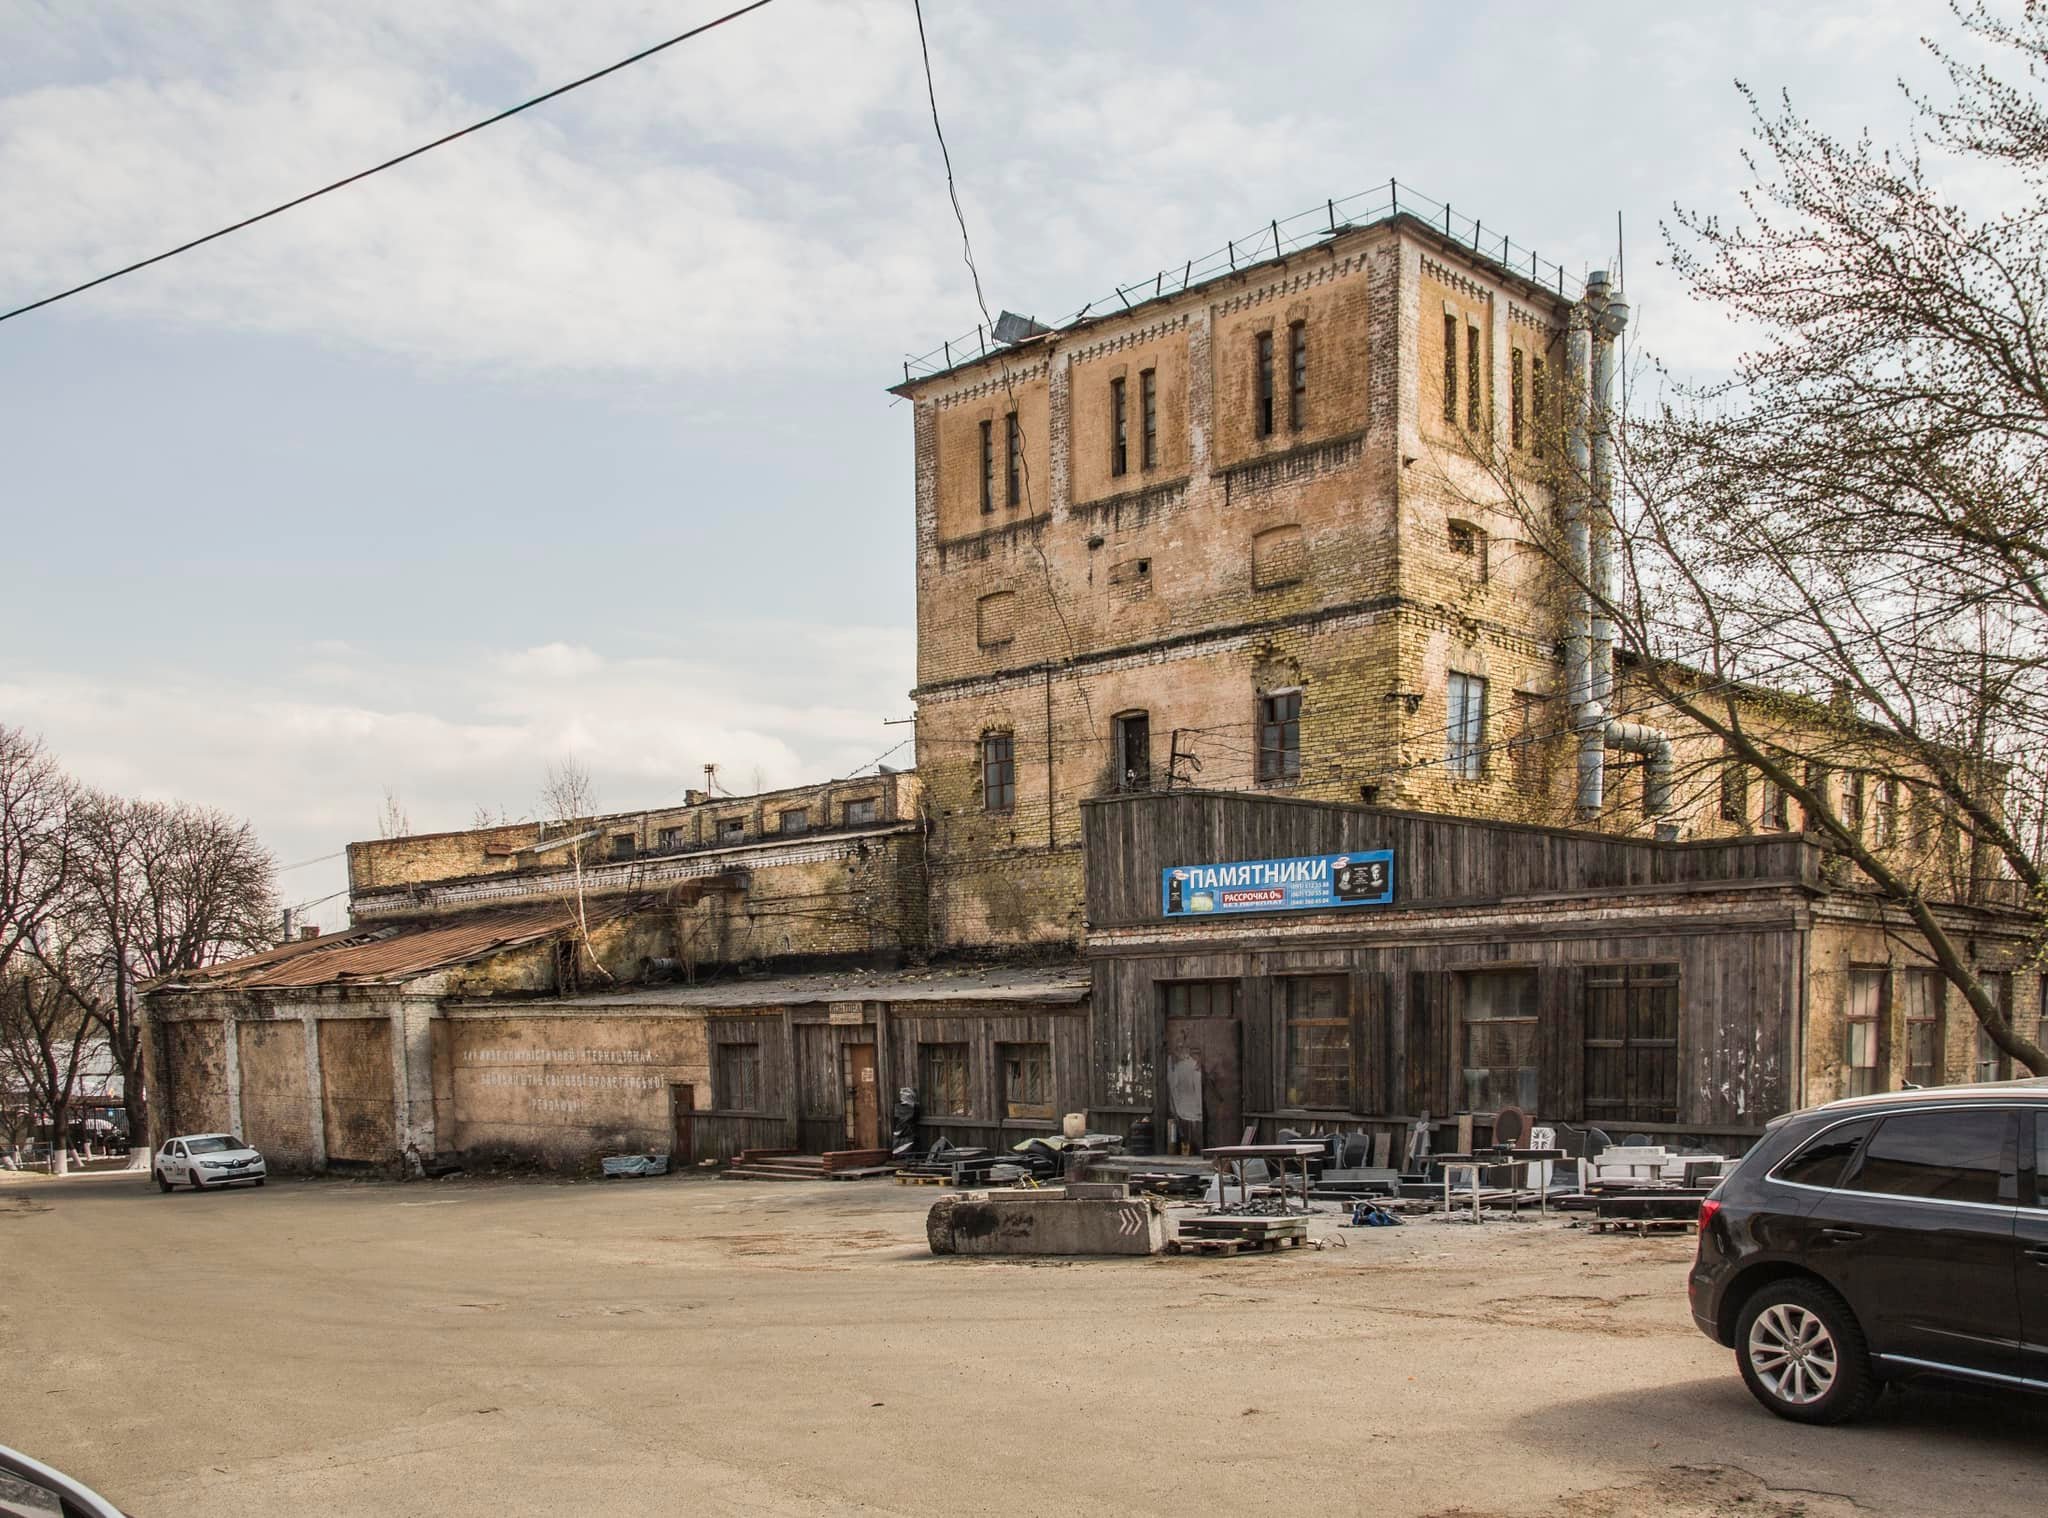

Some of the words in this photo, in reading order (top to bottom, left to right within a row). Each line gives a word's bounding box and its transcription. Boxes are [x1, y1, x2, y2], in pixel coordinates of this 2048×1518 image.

[1190, 859, 1326, 889] ПАМЯТНИКИ
[1224, 892, 1268, 902] РАССРОЧКА
[1269, 890, 1282, 900] 0%
